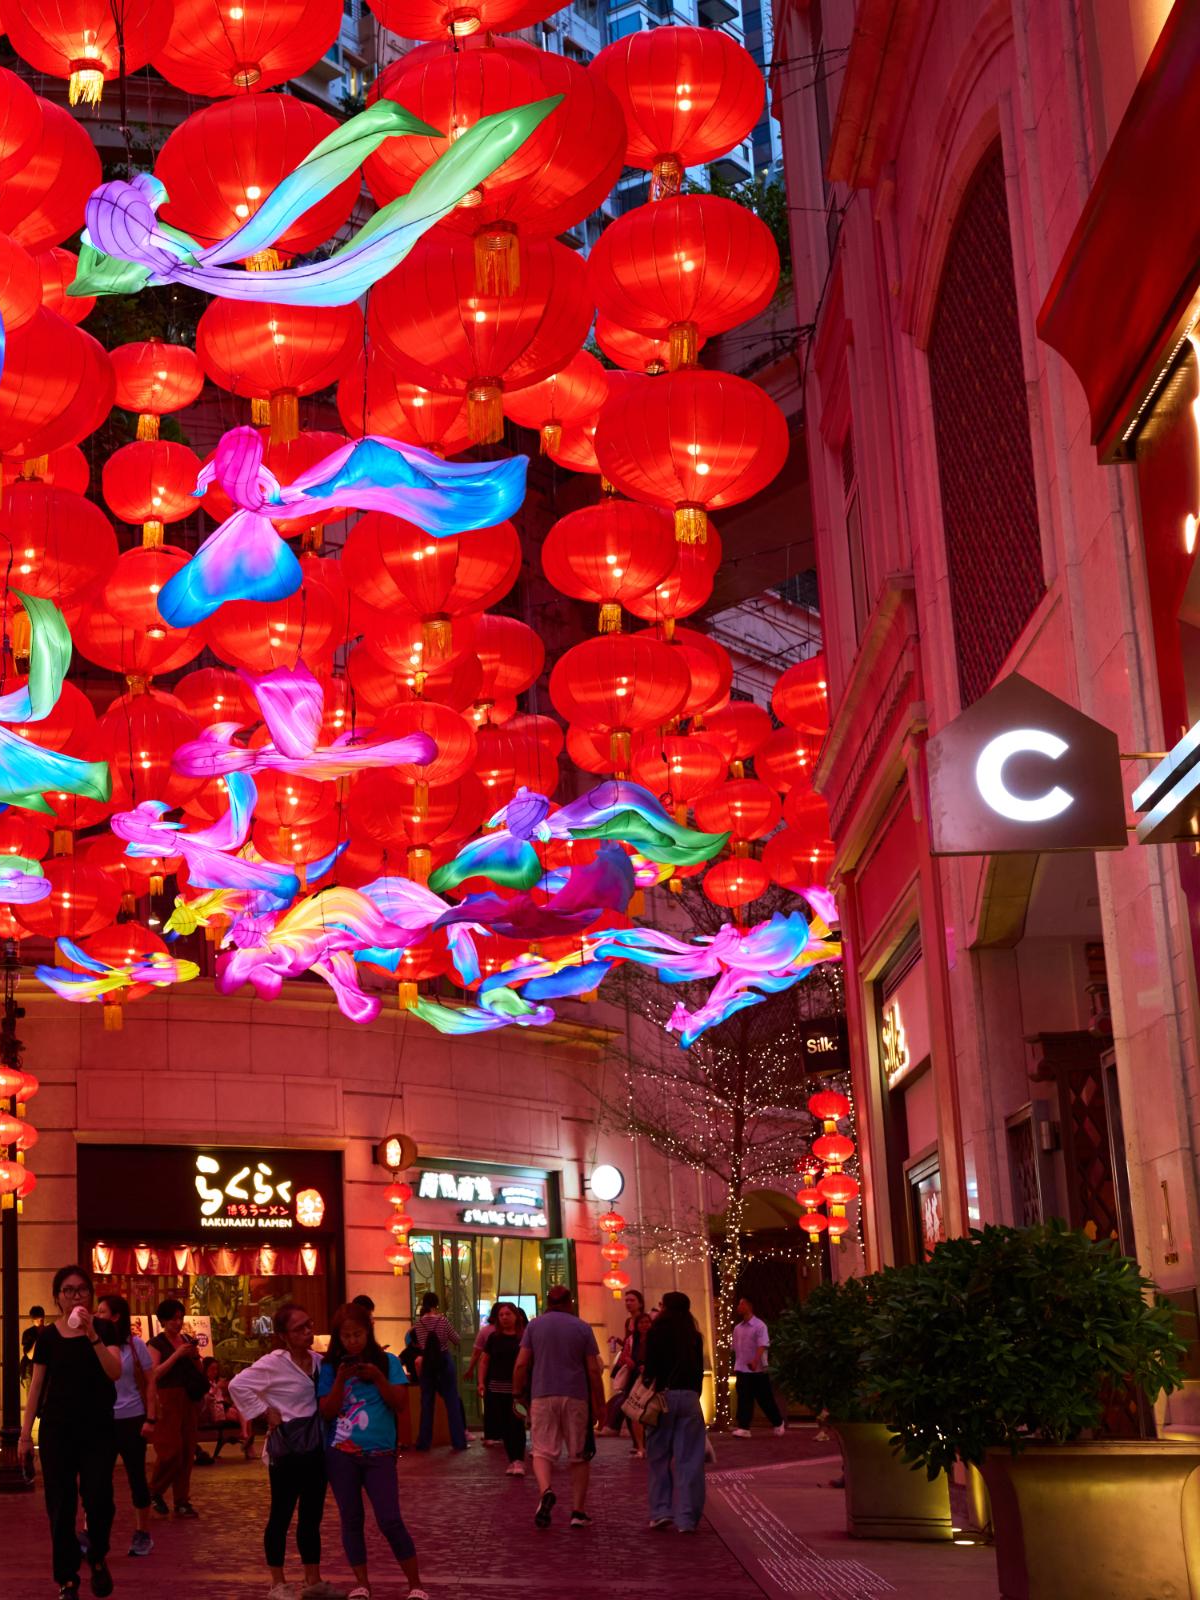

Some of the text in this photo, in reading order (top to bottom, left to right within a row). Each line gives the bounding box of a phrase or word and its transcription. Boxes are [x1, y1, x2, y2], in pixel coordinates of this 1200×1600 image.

[976, 729, 1074, 822] C
[806, 1036, 838, 1054] Silk.
[195, 1155, 292, 1216] らくらく
[227, 1204, 289, 1216] 博多ラーメン
[201, 1218, 292, 1228] RAKURAKU RAMEN
